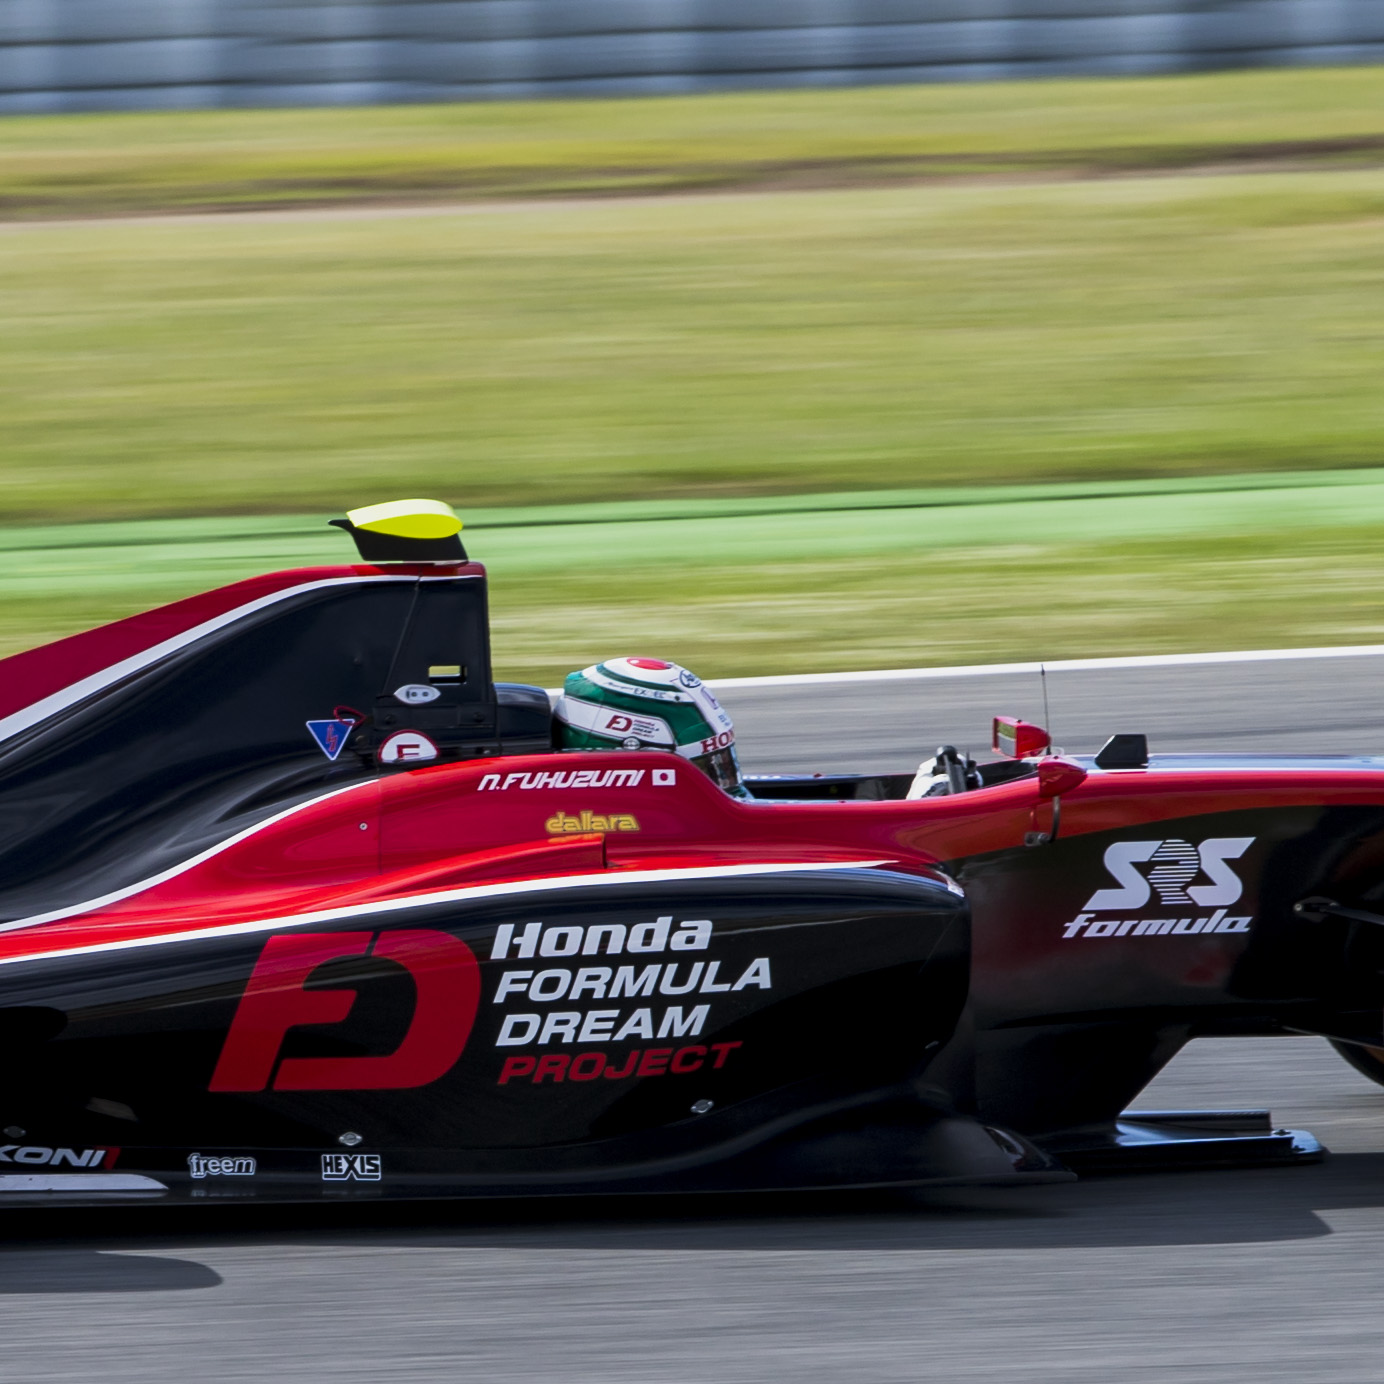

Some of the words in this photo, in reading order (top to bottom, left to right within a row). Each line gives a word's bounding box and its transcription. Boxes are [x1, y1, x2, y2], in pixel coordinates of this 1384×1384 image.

[545, 811, 640, 833] dallara
[490, 916, 713, 961] Honda
[1062, 909, 1253, 938] formula
[492, 957, 772, 1003] FORMULA
[495, 1005, 711, 1047] DREAM
[497, 1041, 743, 1086] PROJECT
[189, 1154, 255, 1176] freem
[322, 1154, 382, 1180] HEXIS
